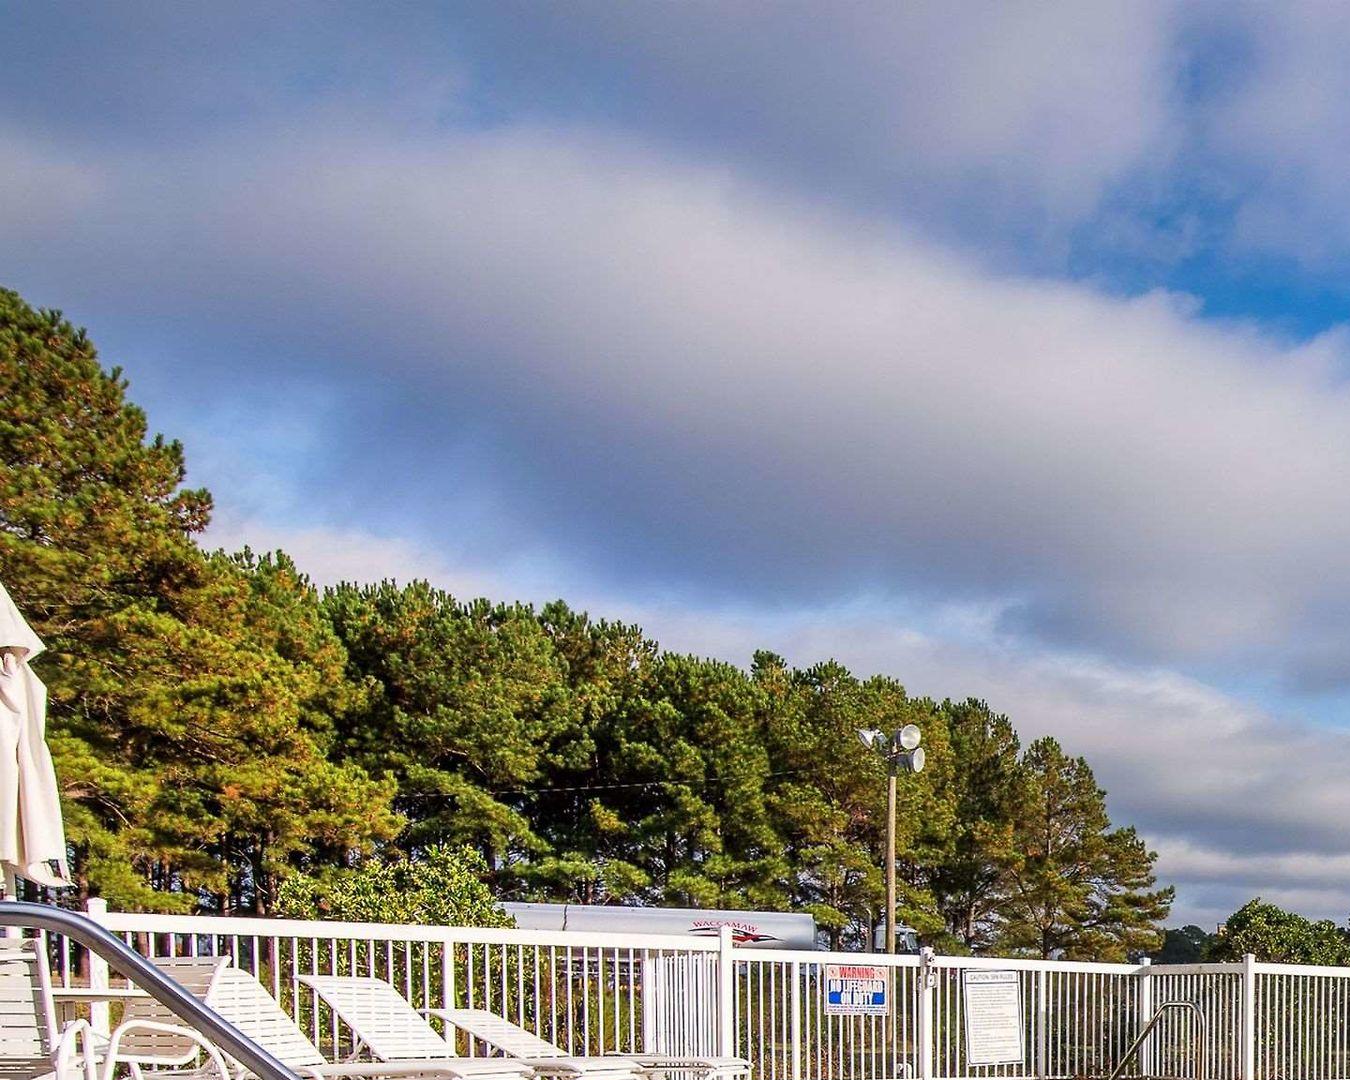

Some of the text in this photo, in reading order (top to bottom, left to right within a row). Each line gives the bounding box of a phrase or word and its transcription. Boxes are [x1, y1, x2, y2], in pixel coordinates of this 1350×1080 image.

[839, 967, 875, 979] WARNING
[831, 980, 883, 993] NO LIFEGUARD
[841, 992, 873, 1005] ON DUTY
